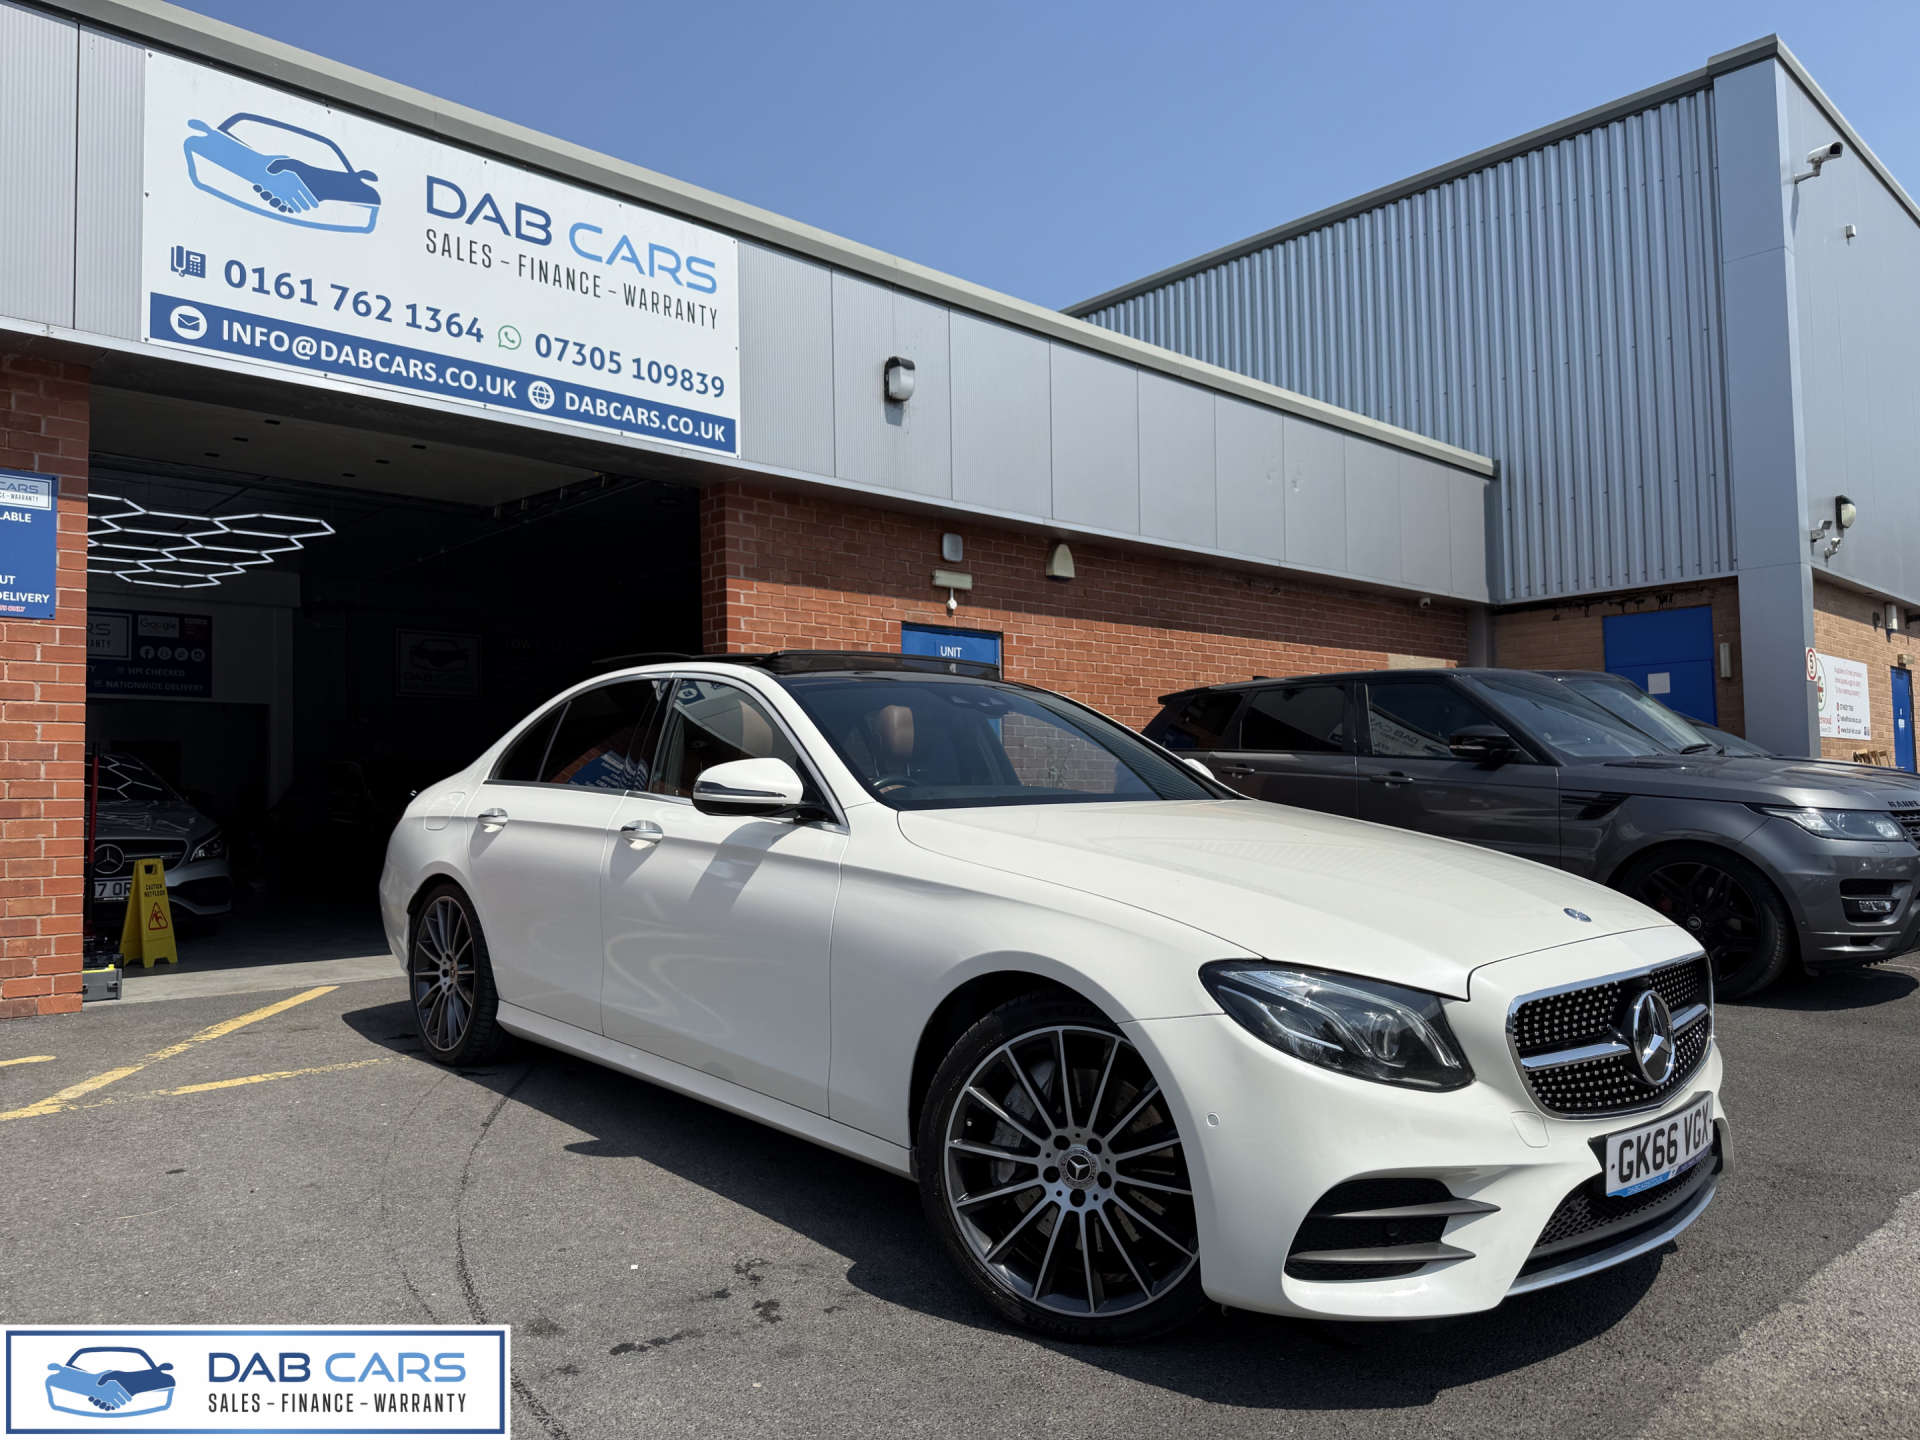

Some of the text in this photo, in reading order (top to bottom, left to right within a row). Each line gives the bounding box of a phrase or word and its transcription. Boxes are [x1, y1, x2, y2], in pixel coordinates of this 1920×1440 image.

[426, 174, 718, 295] DAB CARS
[425, 228, 493, 269] SALES
[518, 253, 602, 299] FINANCE
[623, 282, 719, 330] WARRANTY
[222, 319, 518, 399] INFO@DABCARS.CO.UK
[224, 259, 726, 399] 0161 762 1364 07305 109839
[565, 391, 727, 443] DABCARS.CO.UK
[0, 511, 32, 523] ABLE
[106, 680, 164, 690] NATIONWIDE
[940, 645, 962, 658] UNIT
[1618, 1101, 1709, 1184] GK66 VGX
